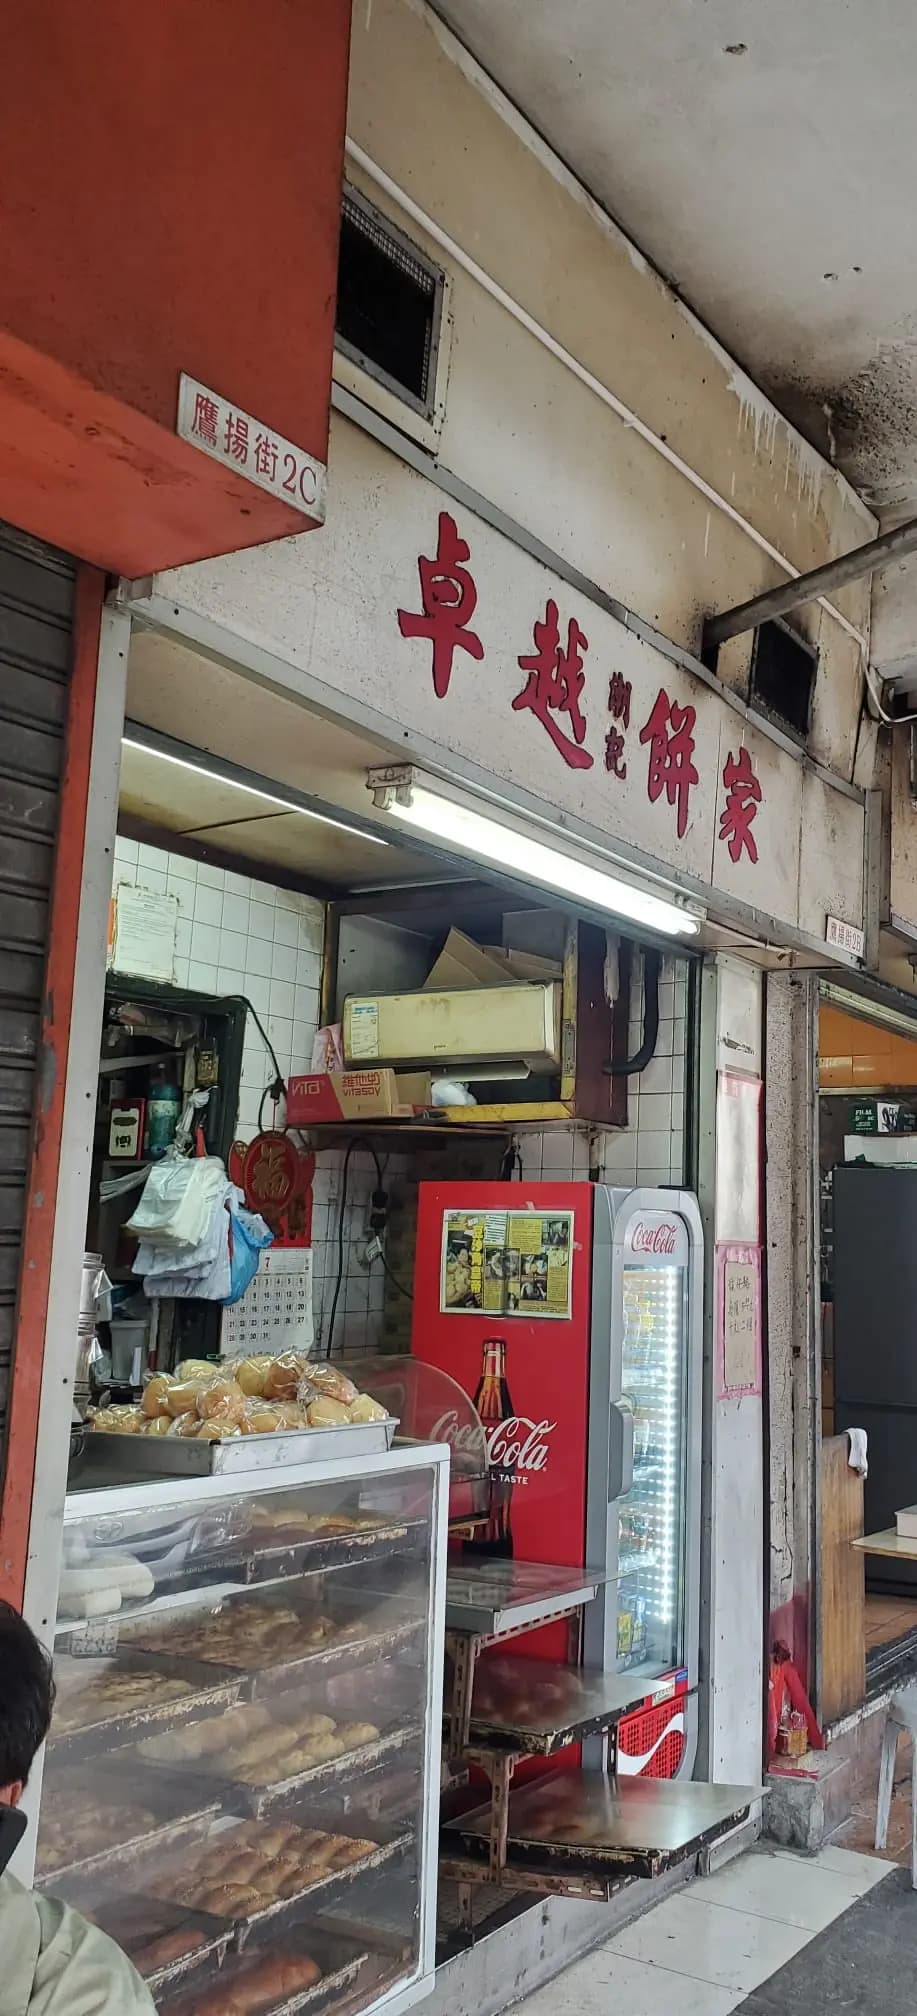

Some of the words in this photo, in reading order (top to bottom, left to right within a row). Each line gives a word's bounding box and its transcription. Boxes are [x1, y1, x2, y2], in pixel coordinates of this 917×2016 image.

[191, 392, 317, 506] 鷹揚街2C
[397, 511, 763, 864] 卓越餅家
[499, 1473, 529, 1485] TASTE
